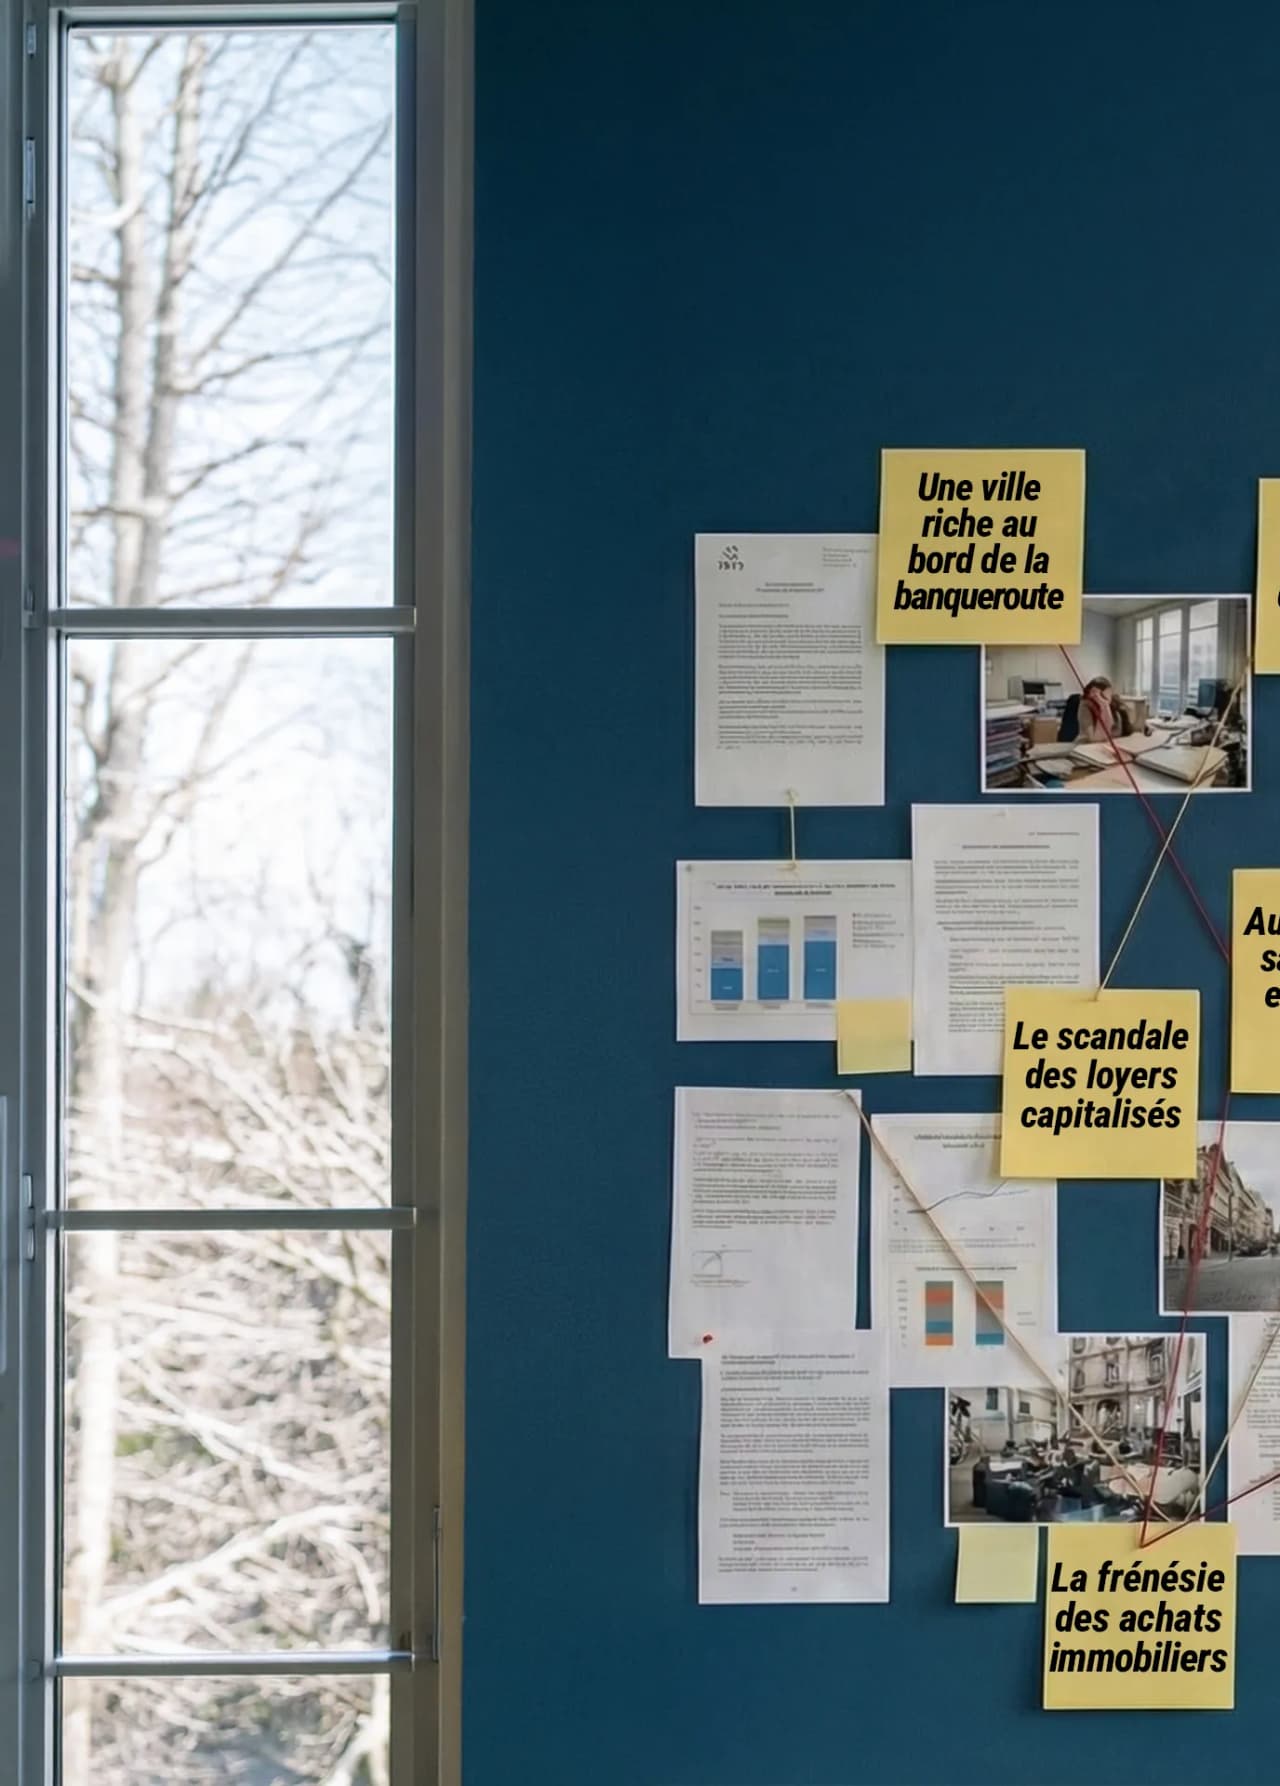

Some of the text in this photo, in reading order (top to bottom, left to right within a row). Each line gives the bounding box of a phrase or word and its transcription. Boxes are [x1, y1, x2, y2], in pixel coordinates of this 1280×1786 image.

[918, 470, 1041, 502] Une ville
[921, 507, 1038, 538] riche au
[907, 542, 976, 574] bord
[980, 542, 1017, 574] de
[1023, 543, 1050, 574] la
[893, 579, 1065, 618] banqueroute
[1013, 1019, 1189, 1050] Le scandale
[1025, 1058, 1178, 1097] des loyers
[1020, 1097, 1182, 1136] capitalisés
[1052, 1560, 1225, 1593] La frénésie
[1055, 1600, 1222, 1633] des achats
[1049, 1640, 1228, 1673] immobiliers
